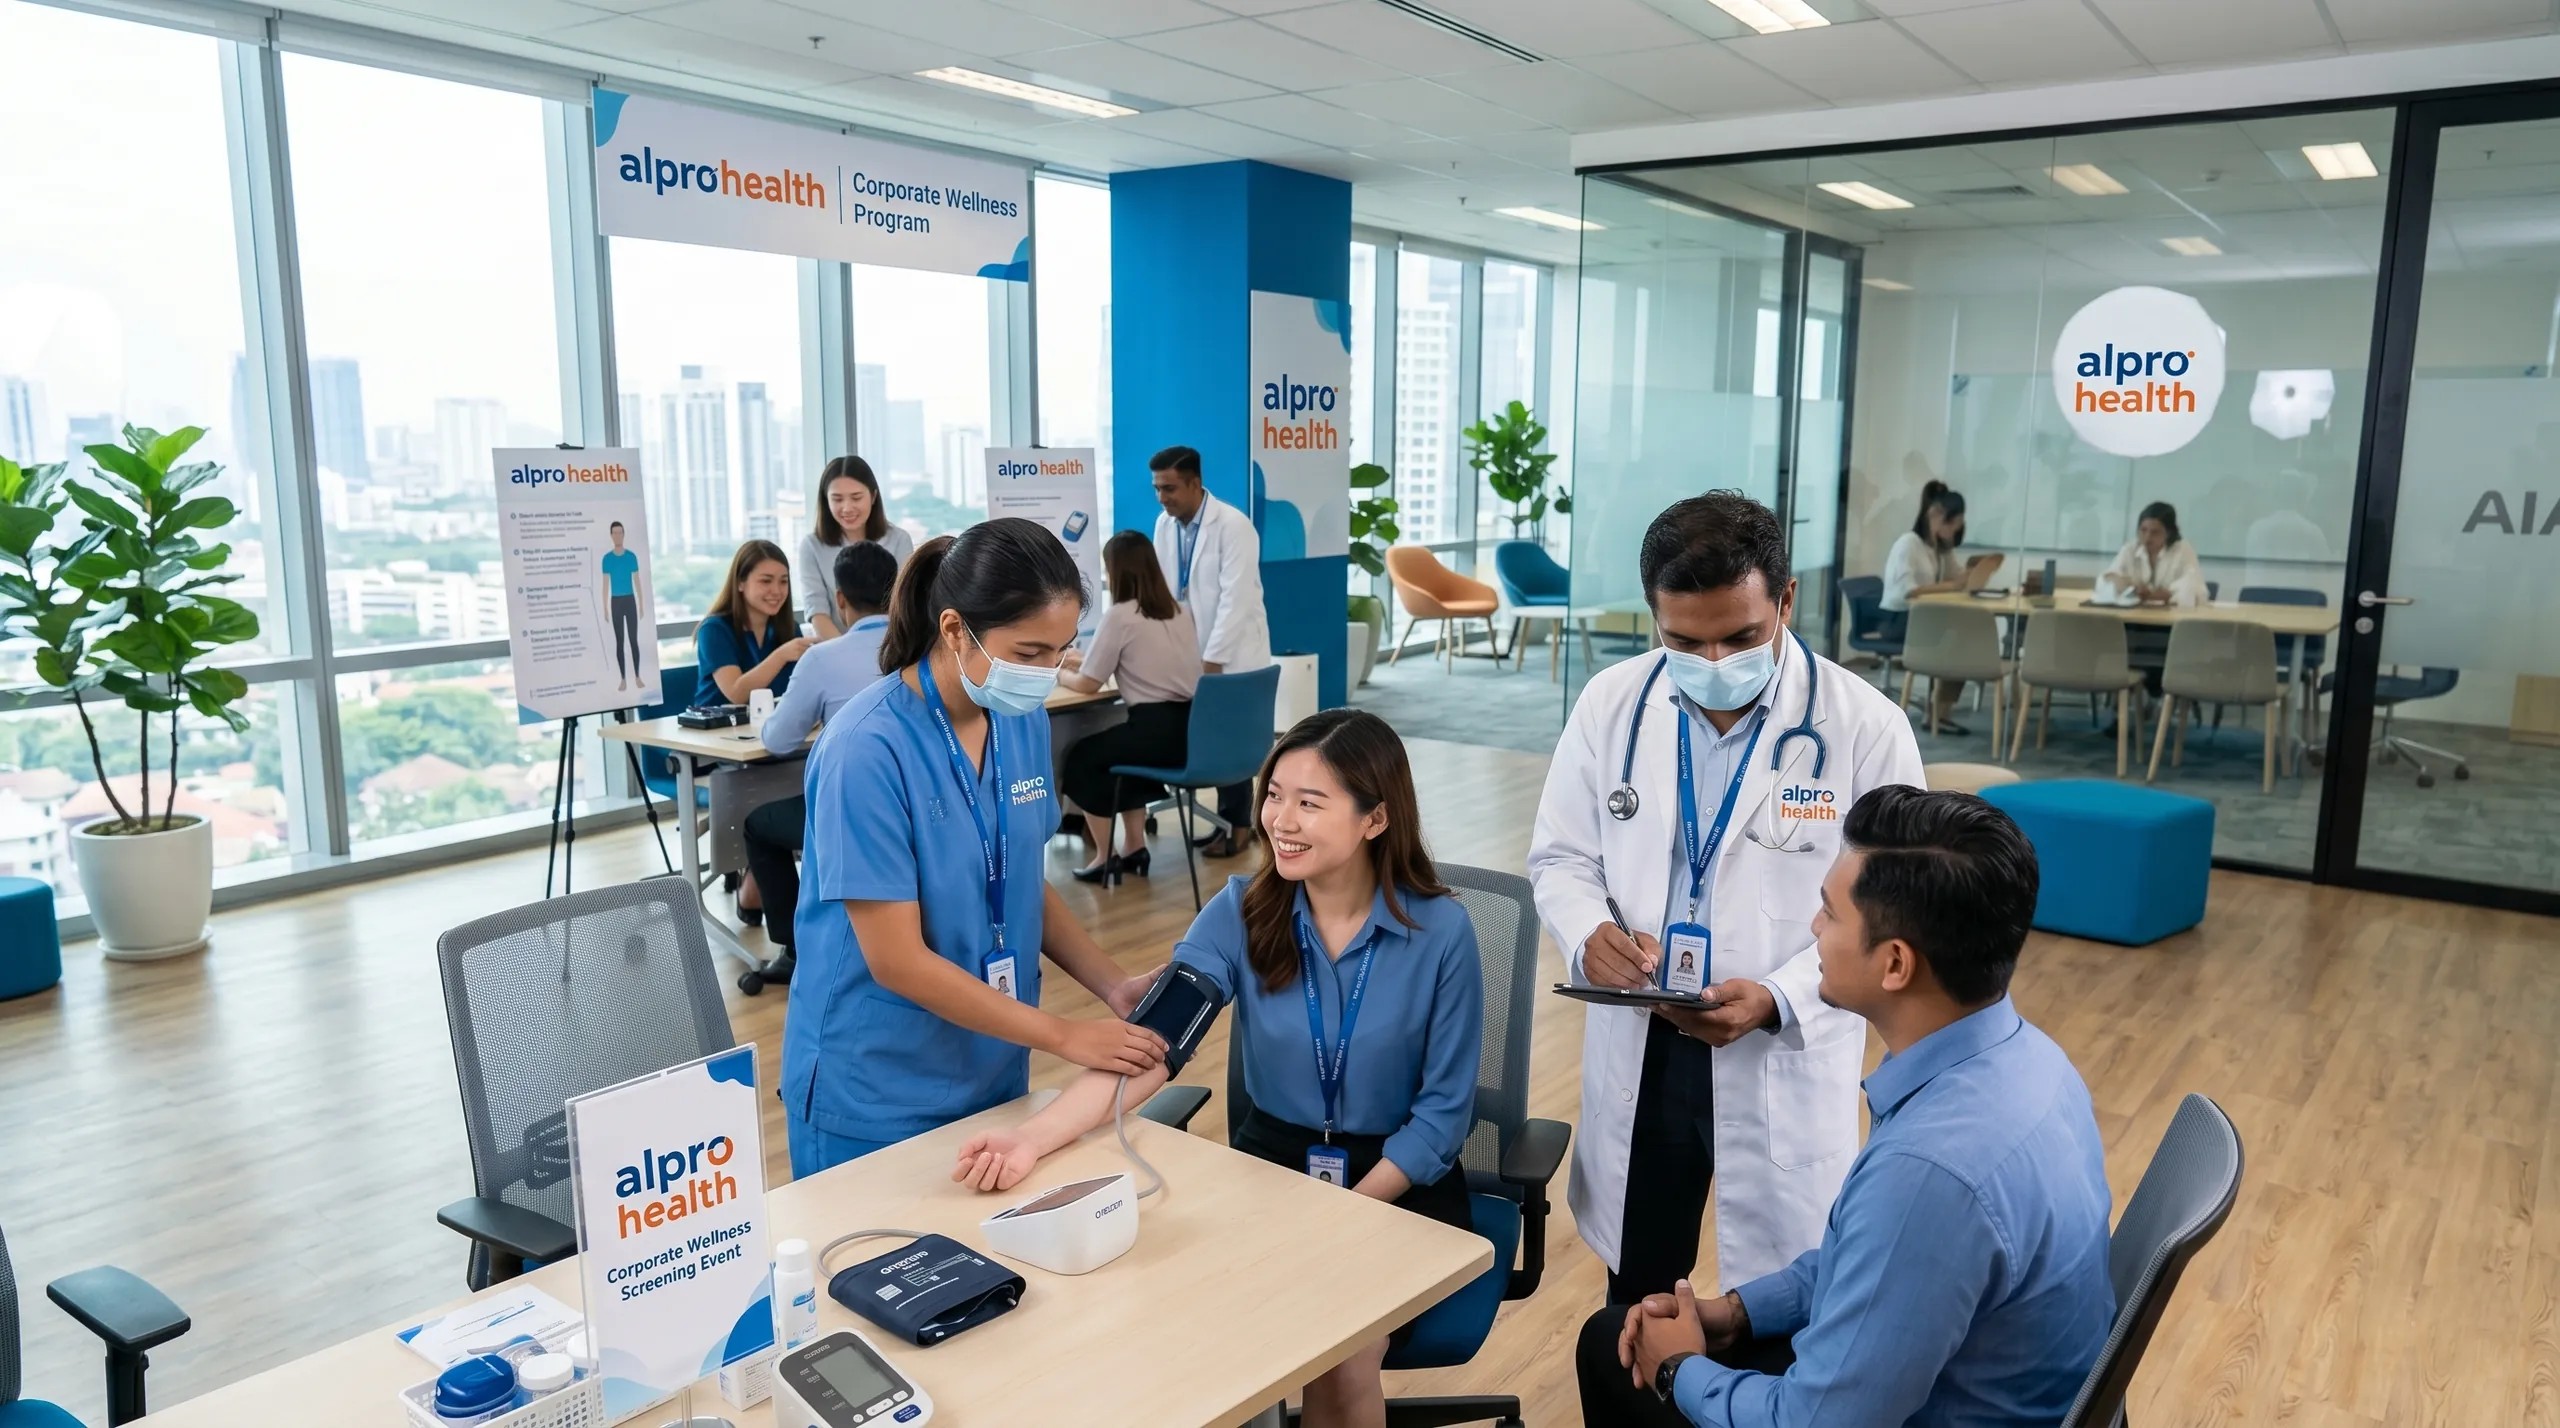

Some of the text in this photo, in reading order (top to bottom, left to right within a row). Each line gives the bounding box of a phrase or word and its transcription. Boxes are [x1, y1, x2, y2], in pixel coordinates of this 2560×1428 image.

[853, 172, 1018, 218] Corporate Wellness
[854, 203, 931, 233] Program
[2076, 343, 2189, 386] alpro
[1263, 373, 1336, 420] alpro
[2075, 381, 2196, 413] health
[1263, 416, 1338, 450] health
[1010, 776, 1045, 794] alpro
[1012, 788, 1048, 806] health
[1781, 784, 1835, 805] alpro
[1780, 801, 1837, 820] health
[615, 1135, 735, 1199] alpro
[616, 1170, 738, 1240] health
[606, 1221, 752, 1284] Corporate Wellness
[621, 1243, 742, 1301] Screening Event
